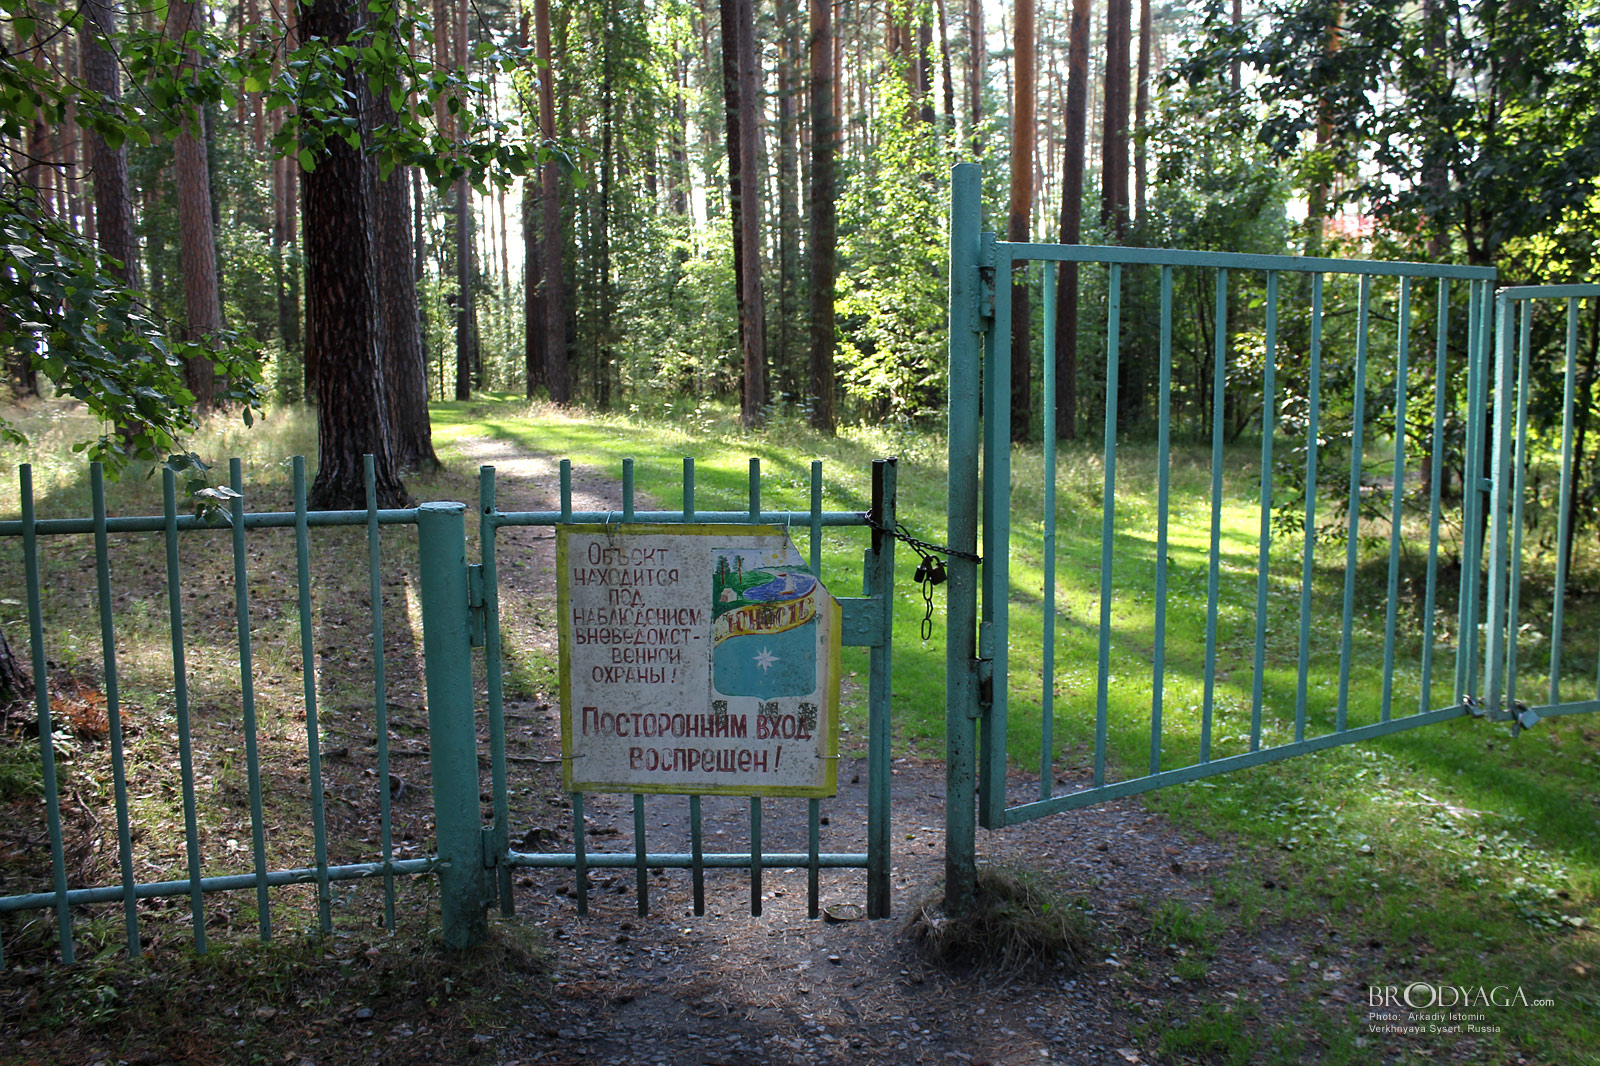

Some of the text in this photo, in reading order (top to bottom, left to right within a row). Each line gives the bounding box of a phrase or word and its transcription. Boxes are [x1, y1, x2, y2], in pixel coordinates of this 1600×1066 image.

[573, 568, 679, 588] НАХОДИТСЯ
[608, 588, 646, 608] ПОД
[756, 713, 813, 741] ВХОД
